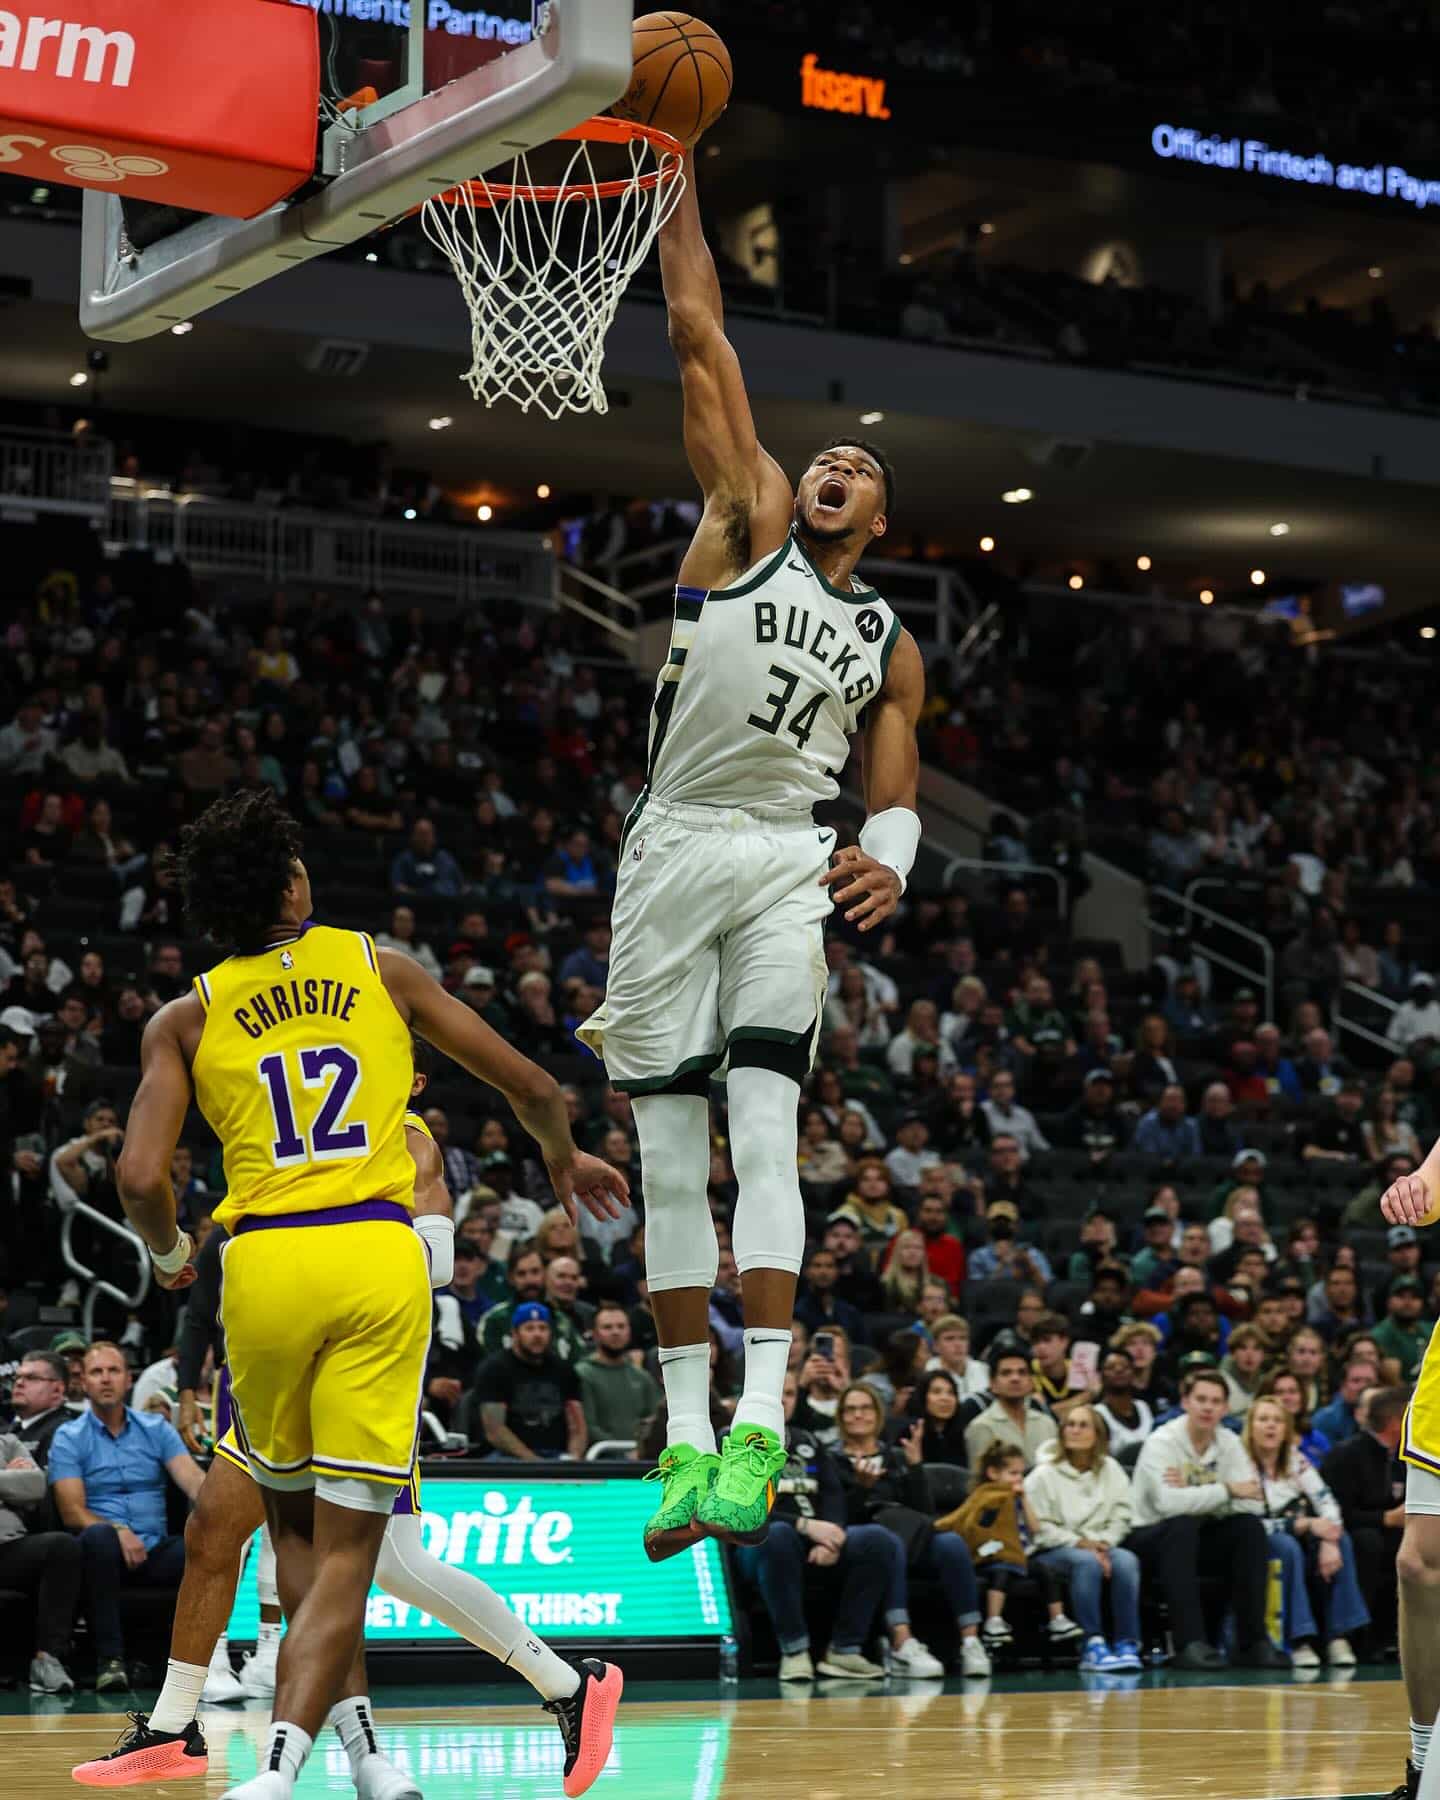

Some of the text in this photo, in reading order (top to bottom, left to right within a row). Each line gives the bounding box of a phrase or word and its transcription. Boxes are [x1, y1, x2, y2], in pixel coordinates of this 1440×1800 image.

[1152, 124, 1240, 169] Official
[1243, 140, 1333, 185] Fintech
[1335, 164, 1383, 194] and
[754, 602, 875, 705] BUCKS
[747, 664, 830, 750] 34
[233, 979, 361, 1040] CHRISTIE
[257, 1043, 370, 1169] 12
